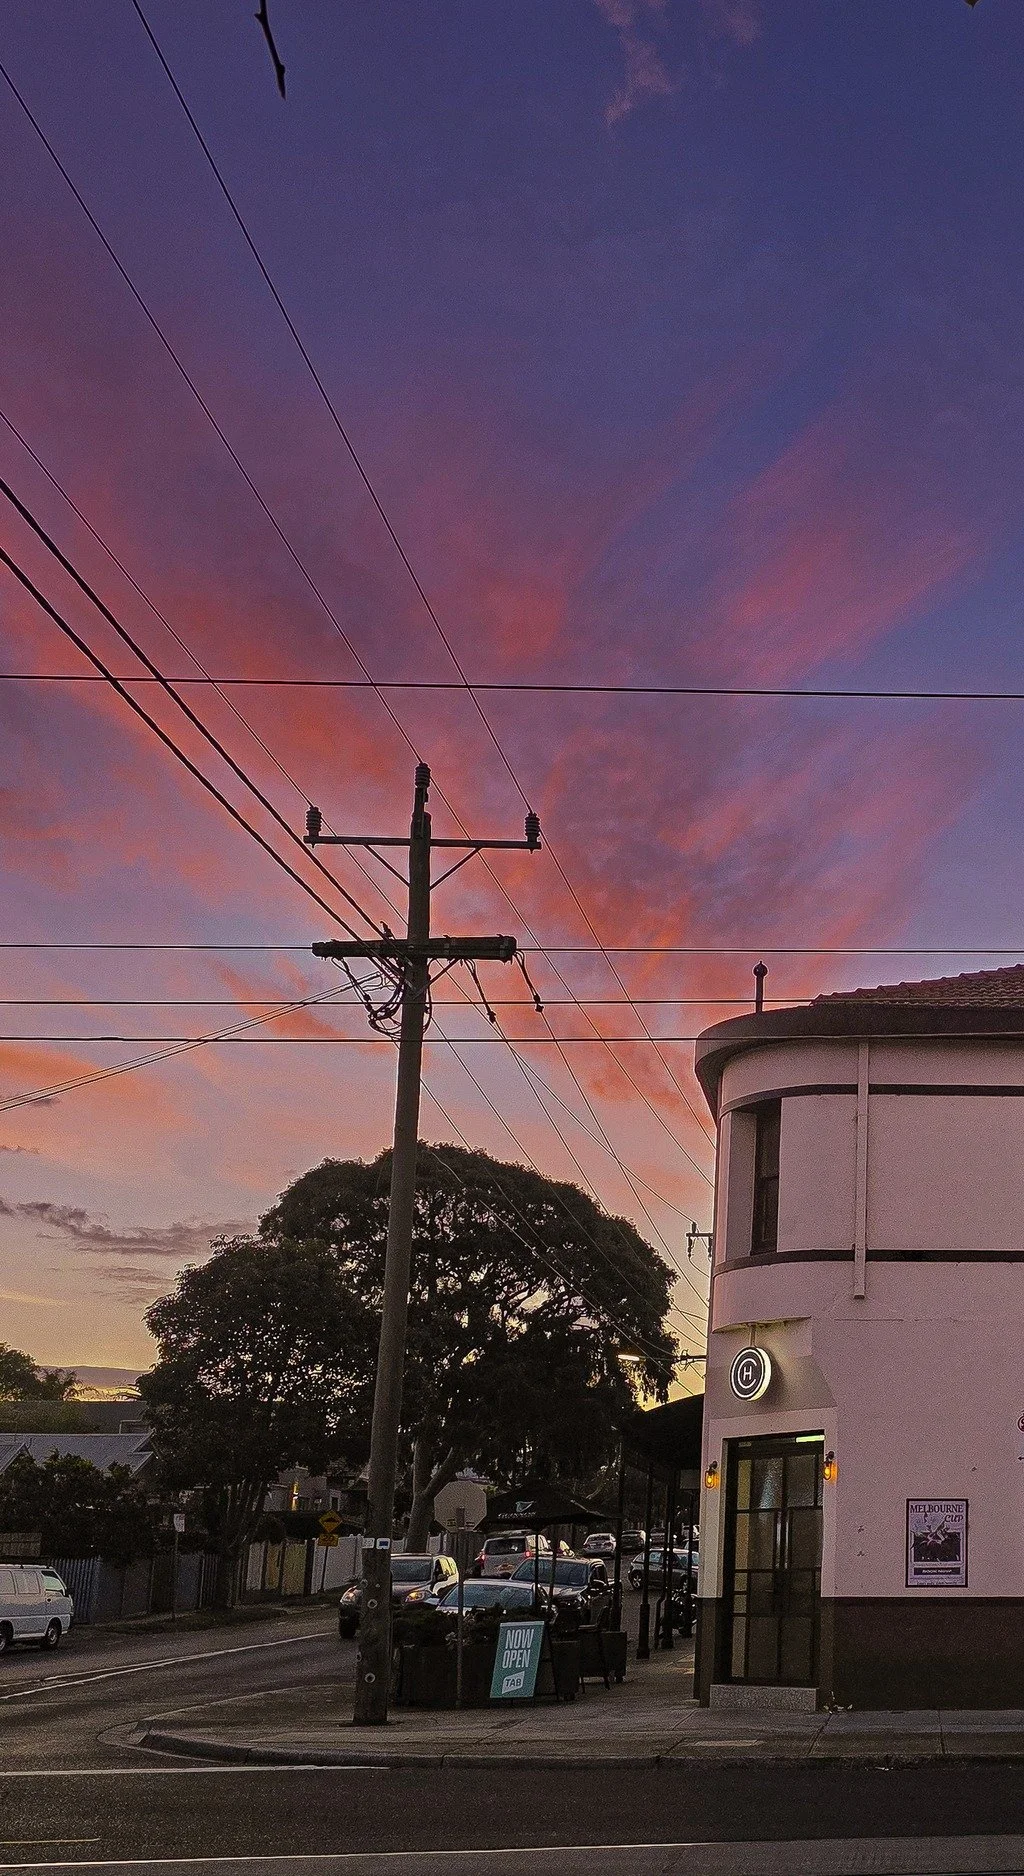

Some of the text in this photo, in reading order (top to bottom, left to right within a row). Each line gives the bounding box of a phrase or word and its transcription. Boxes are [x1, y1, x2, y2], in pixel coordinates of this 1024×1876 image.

[910, 1504, 964, 1513] MELBOURNE
[944, 1514, 964, 1523] CUP
[505, 1628, 535, 1650] NOW
[502, 1649, 531, 1669] OPEN
[505, 1678, 522, 1687] TAB
